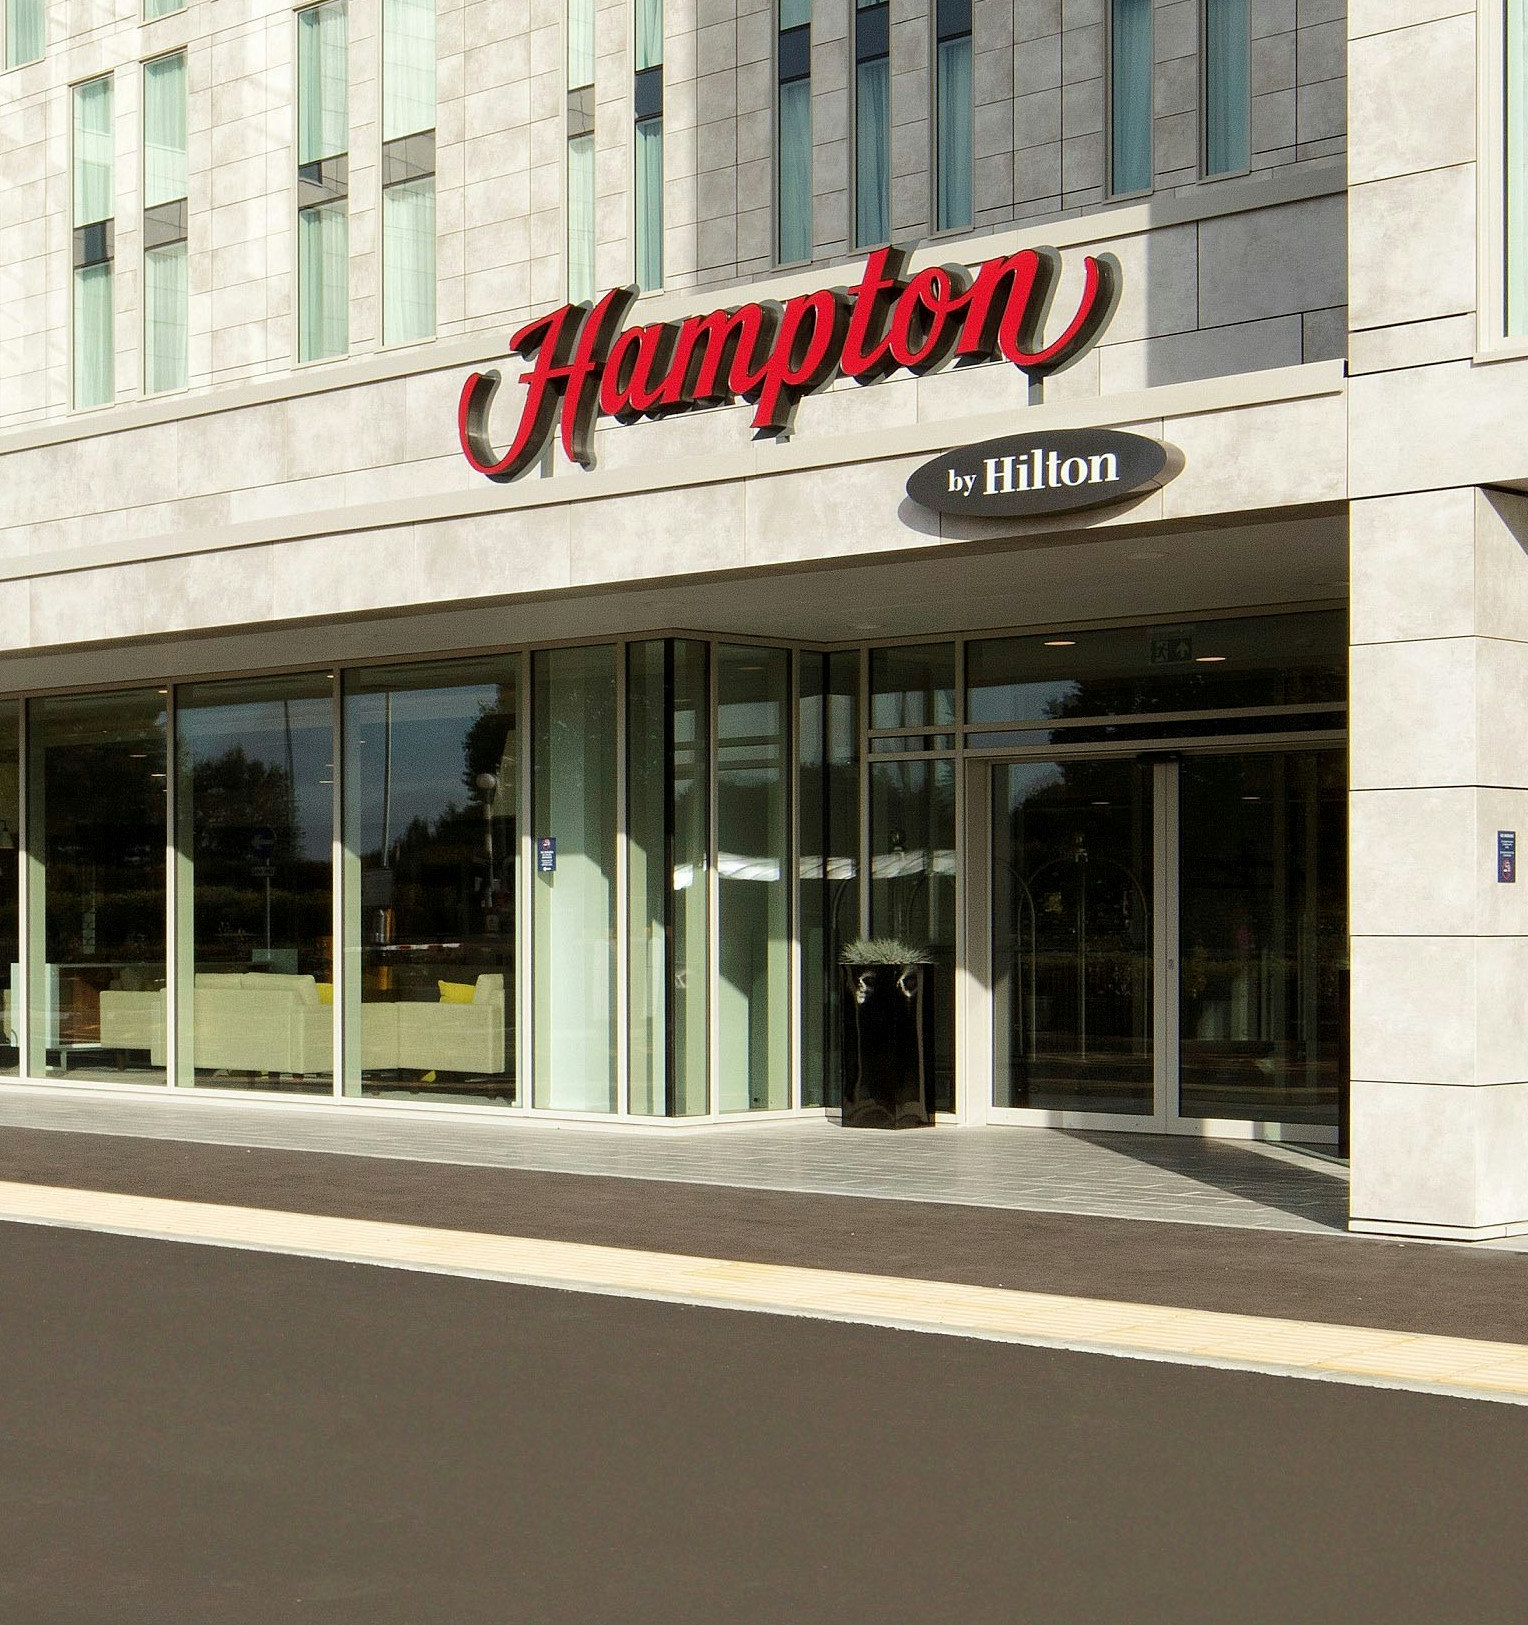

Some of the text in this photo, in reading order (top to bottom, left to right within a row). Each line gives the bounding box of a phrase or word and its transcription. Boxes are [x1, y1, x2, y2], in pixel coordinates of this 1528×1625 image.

[458, 246, 1101, 475] Hampton
[947, 448, 1120, 497] by Hilton
